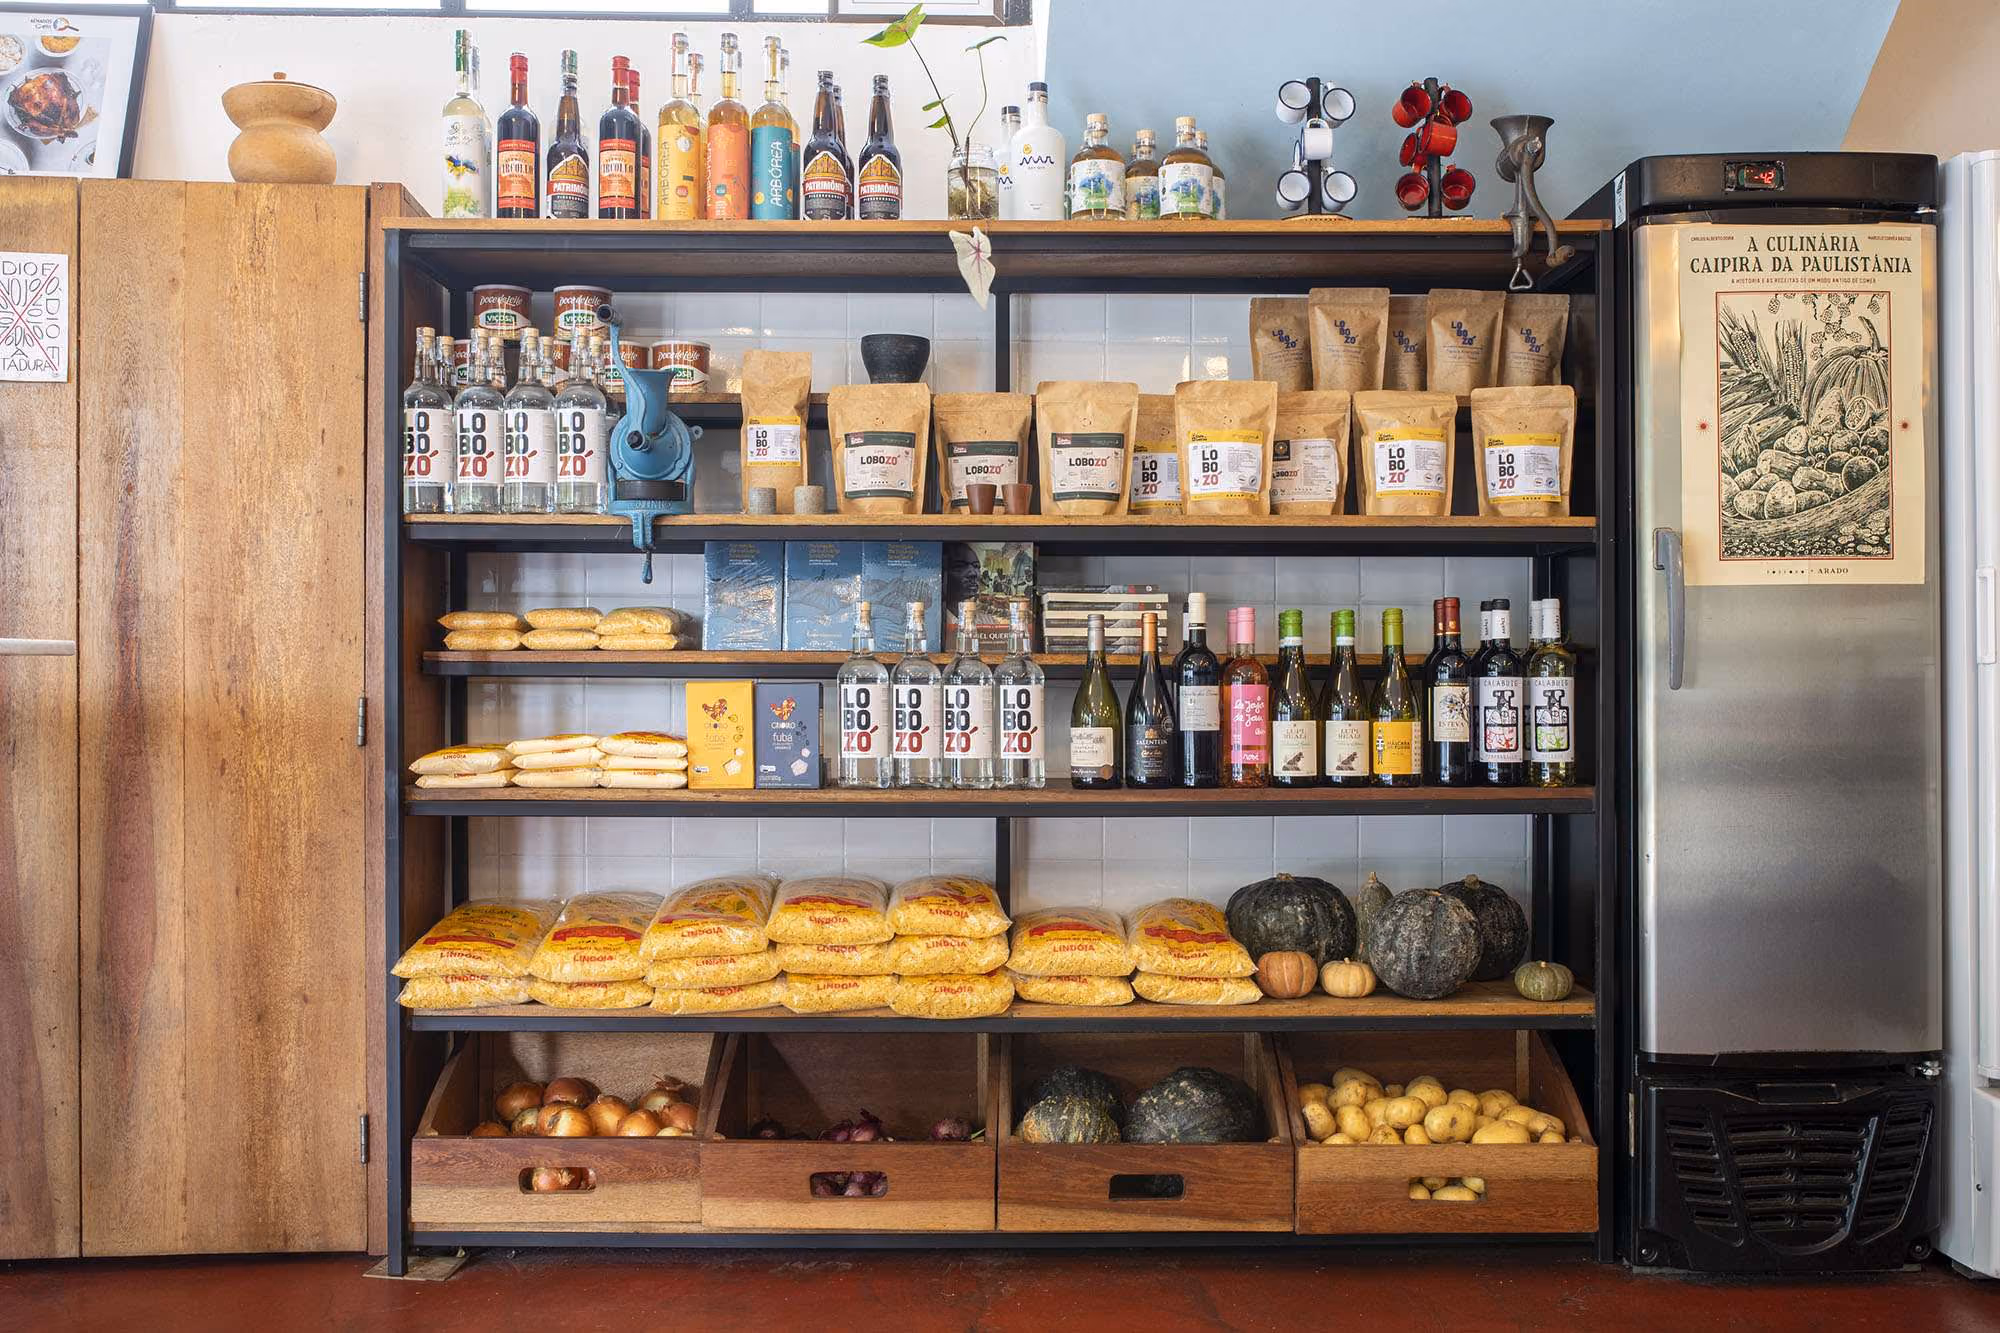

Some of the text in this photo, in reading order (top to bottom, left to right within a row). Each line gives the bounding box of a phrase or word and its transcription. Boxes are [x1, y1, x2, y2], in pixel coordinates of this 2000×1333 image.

[1747, 232, 1860, 252] A CULINÁRIA
[2, 261, 55, 276] DIO E
[1690, 256, 1763, 274] CAIPIRA
[1772, 256, 1793, 273] DA
[1, 358, 53, 371] TADURA
[459, 412, 487, 433] LO
[505, 411, 528, 433] LO
[559, 411, 585, 432] LO
[459, 434, 487, 455] BO
[505, 433, 529, 455] BO
[559, 433, 586, 455] BO
[755, 430, 768, 439] LO
[755, 439, 768, 448] BO
[1202, 449, 1218, 460] LO
[1388, 447, 1405, 459] LO
[1498, 453, 1515, 465] LO
[1142, 460, 1158, 471] LO
[1202, 462, 1218, 473] BO
[1388, 459, 1405, 471] BO
[1498, 465, 1515, 477] BO
[1142, 472, 1158, 483] BO
[1817, 567, 1849, 575] ARADO
[843, 688, 870, 709] LO
[895, 688, 921, 709] LO
[945, 688, 970, 709] LO
[1003, 688, 1031, 709] LO
[843, 710, 871, 731] BO
[895, 710, 922, 731] BO
[945, 710, 971, 731] BO
[1003, 710, 1032, 731] BO
